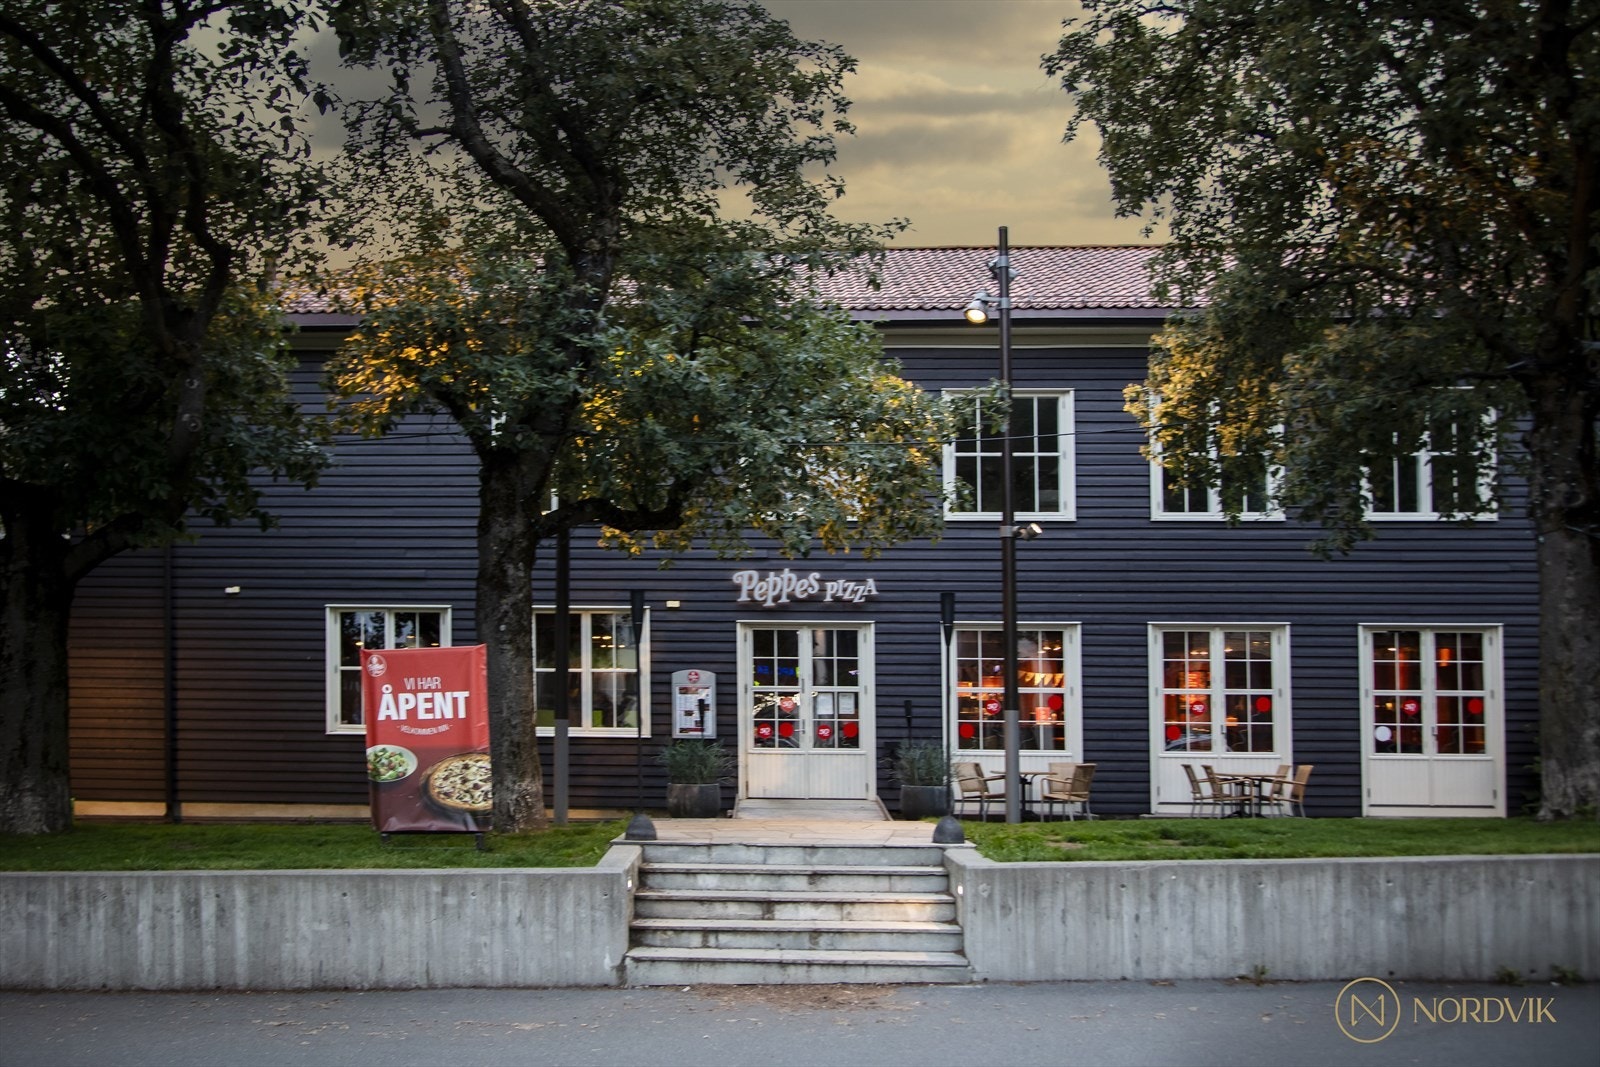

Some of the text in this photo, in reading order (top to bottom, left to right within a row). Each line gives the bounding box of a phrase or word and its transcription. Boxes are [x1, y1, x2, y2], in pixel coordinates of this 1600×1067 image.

[732, 568, 879, 607] Peppes PIZZA
[403, 676, 442, 690] VI HAR
[377, 684, 470, 721] ÅPENT
